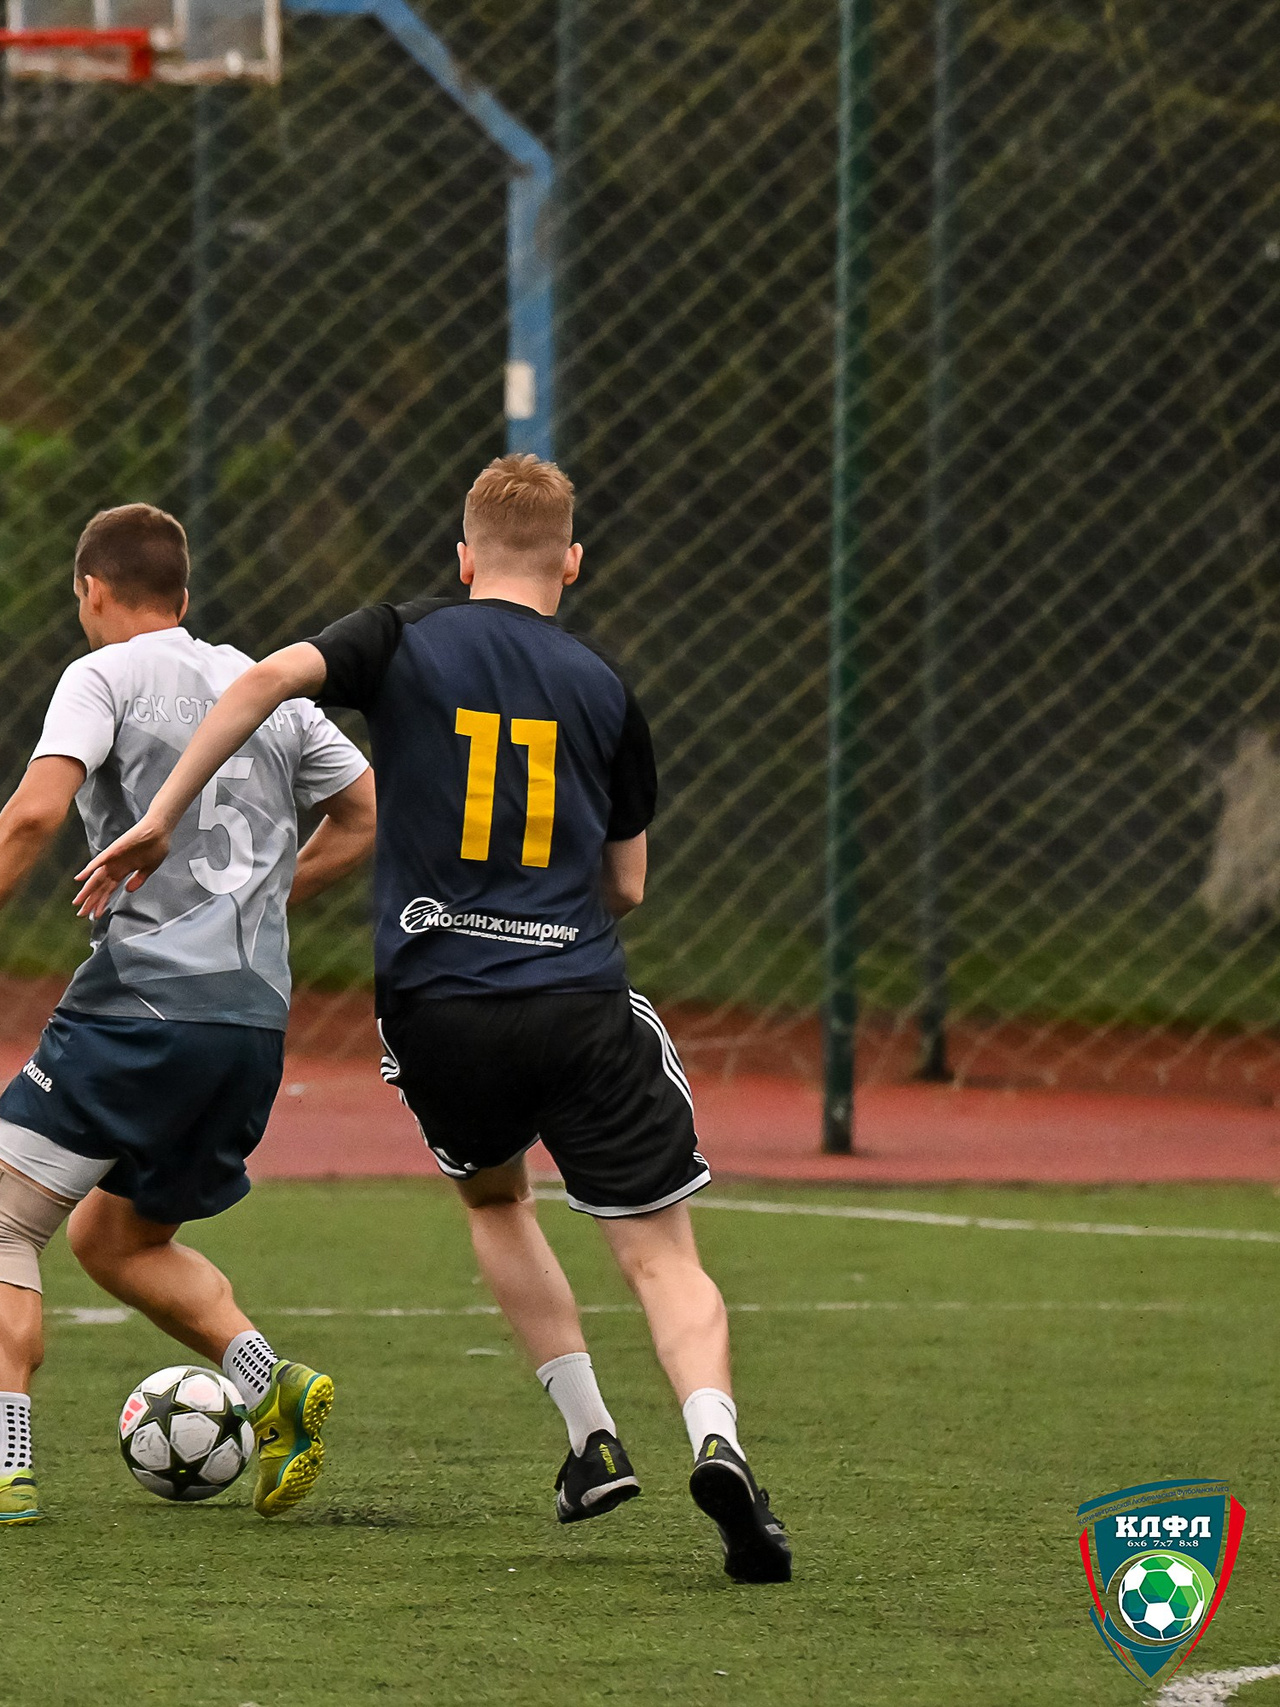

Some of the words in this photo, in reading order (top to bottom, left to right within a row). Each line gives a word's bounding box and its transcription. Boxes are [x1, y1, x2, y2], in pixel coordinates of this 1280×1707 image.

[132, 695, 171, 723] СК
[188, 756, 254, 895] 5
[455, 708, 557, 868] 11
